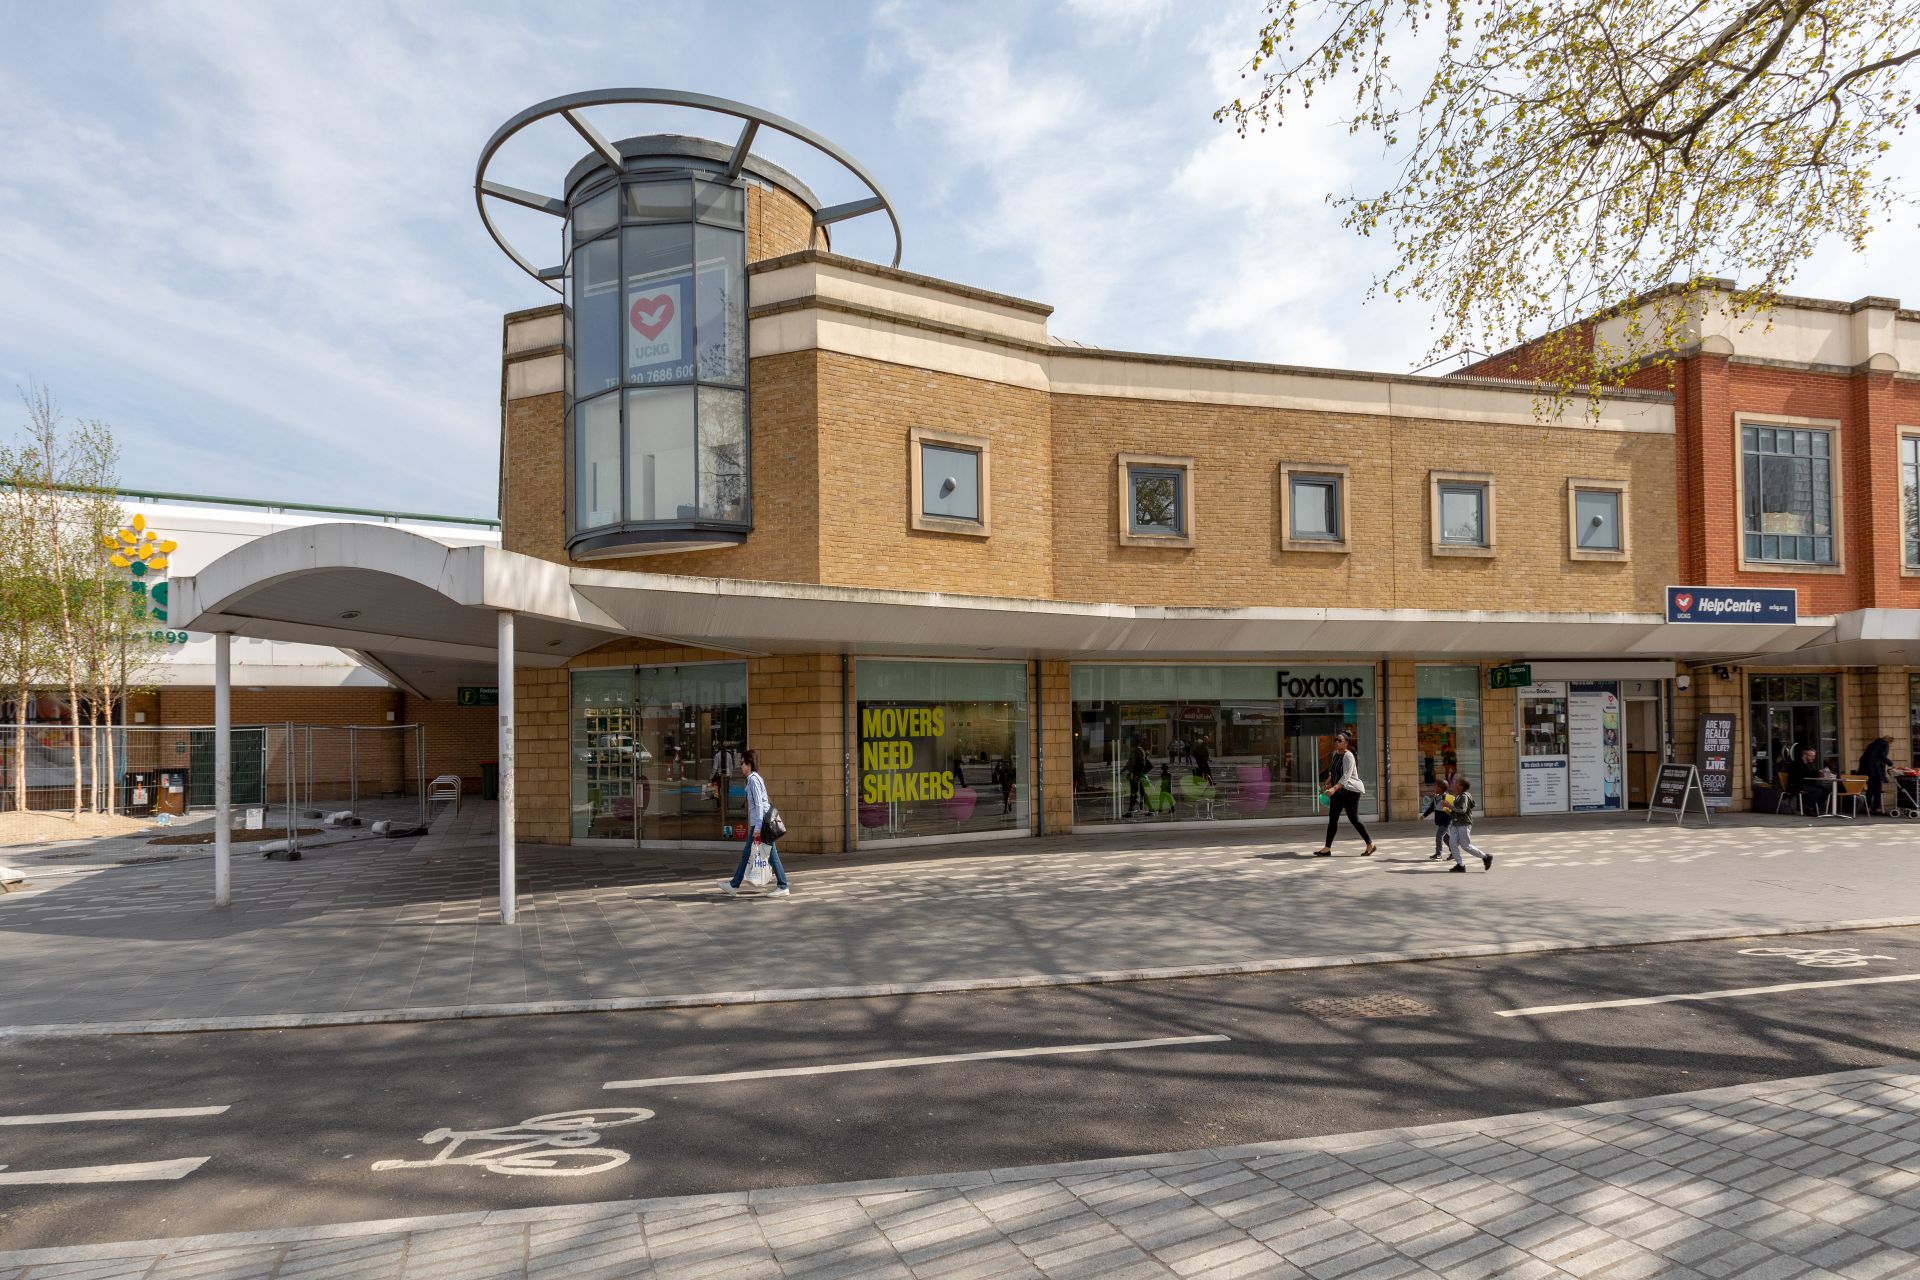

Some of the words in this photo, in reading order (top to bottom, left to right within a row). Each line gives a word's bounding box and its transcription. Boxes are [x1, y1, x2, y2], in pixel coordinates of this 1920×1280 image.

[635, 343, 671, 359] UCKG
[628, 373, 644, 384] 20
[646, 367, 673, 383] 7686
[1698, 597, 1762, 616] HelpCentre
[1277, 671, 1365, 698] Foxtons
[1636, 683, 1642, 692] 7
[862, 706, 945, 738] MOVERS
[1705, 720, 1718, 729] ARE
[1719, 720, 1731, 729] YOU
[1705, 729, 1730, 739] REALLY
[863, 741, 914, 771] NEED
[1704, 744, 1716, 752] BEST
[1705, 761, 1726, 770] LIVE
[863, 770, 956, 804] SHAKERS
